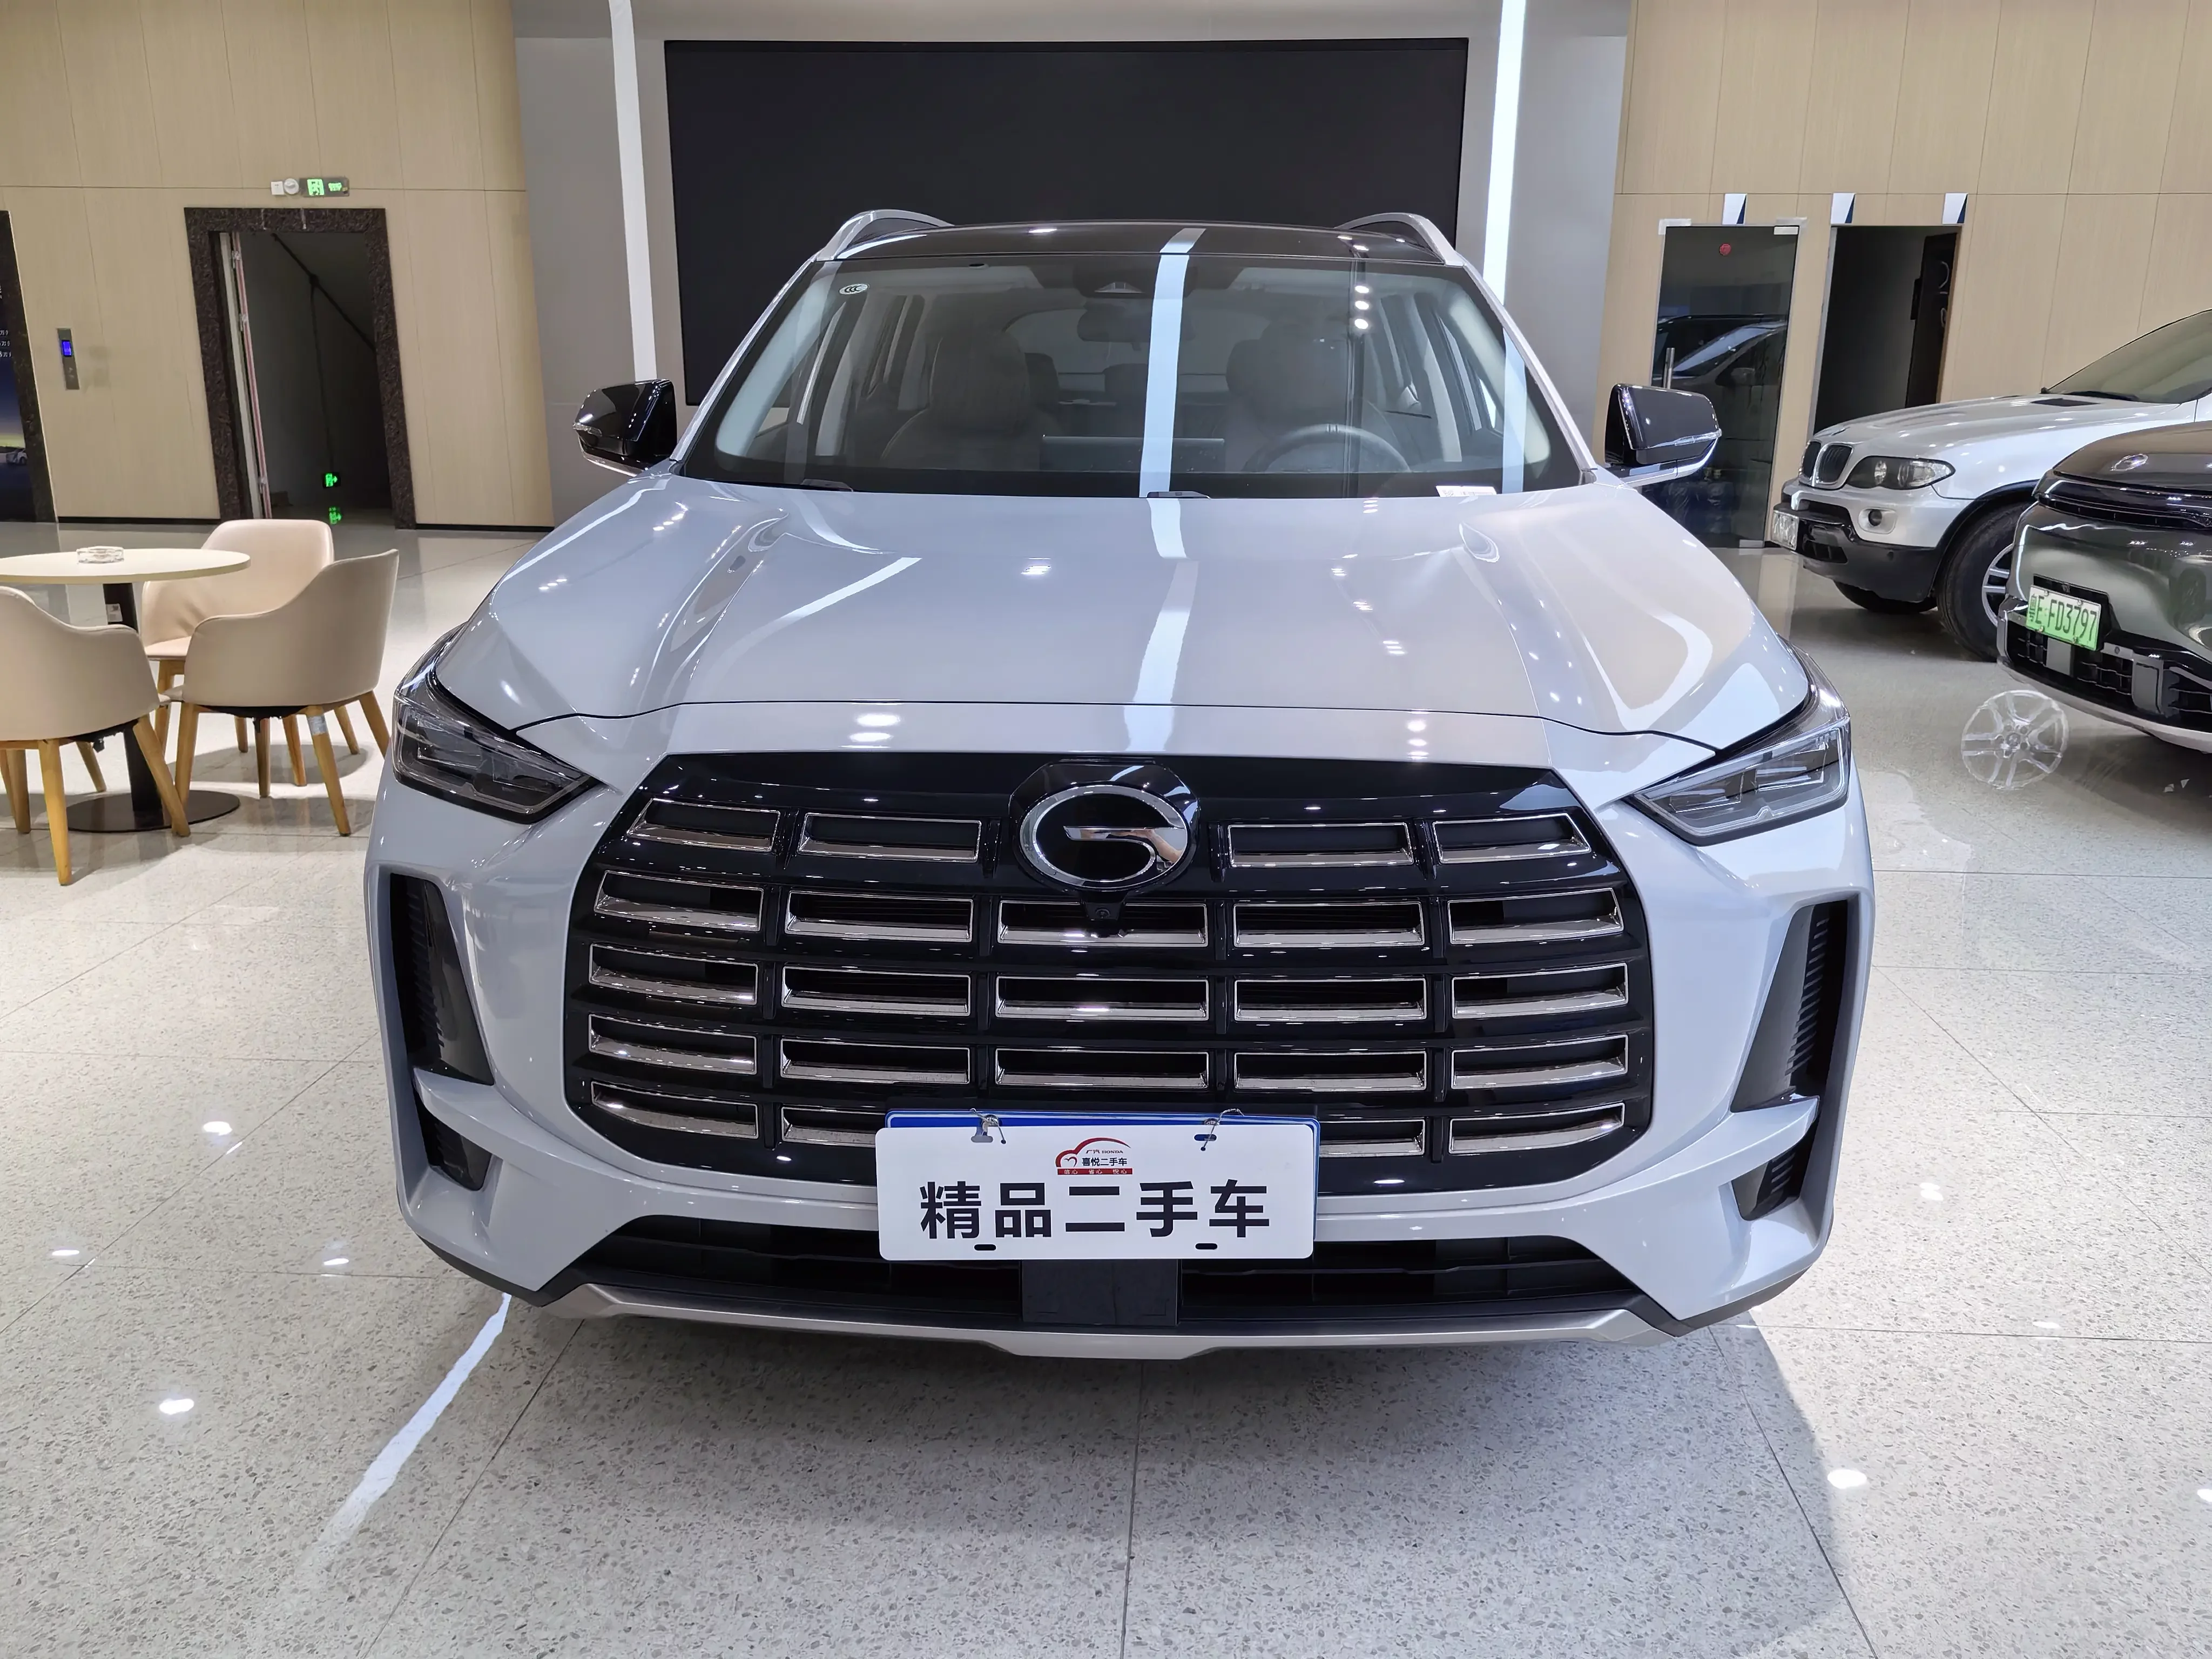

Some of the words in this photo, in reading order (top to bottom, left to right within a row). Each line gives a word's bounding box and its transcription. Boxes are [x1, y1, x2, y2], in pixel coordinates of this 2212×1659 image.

[1082, 1157, 1127, 1166] 喜悦二手车
[919, 1179, 1270, 1239] 精品二手车
